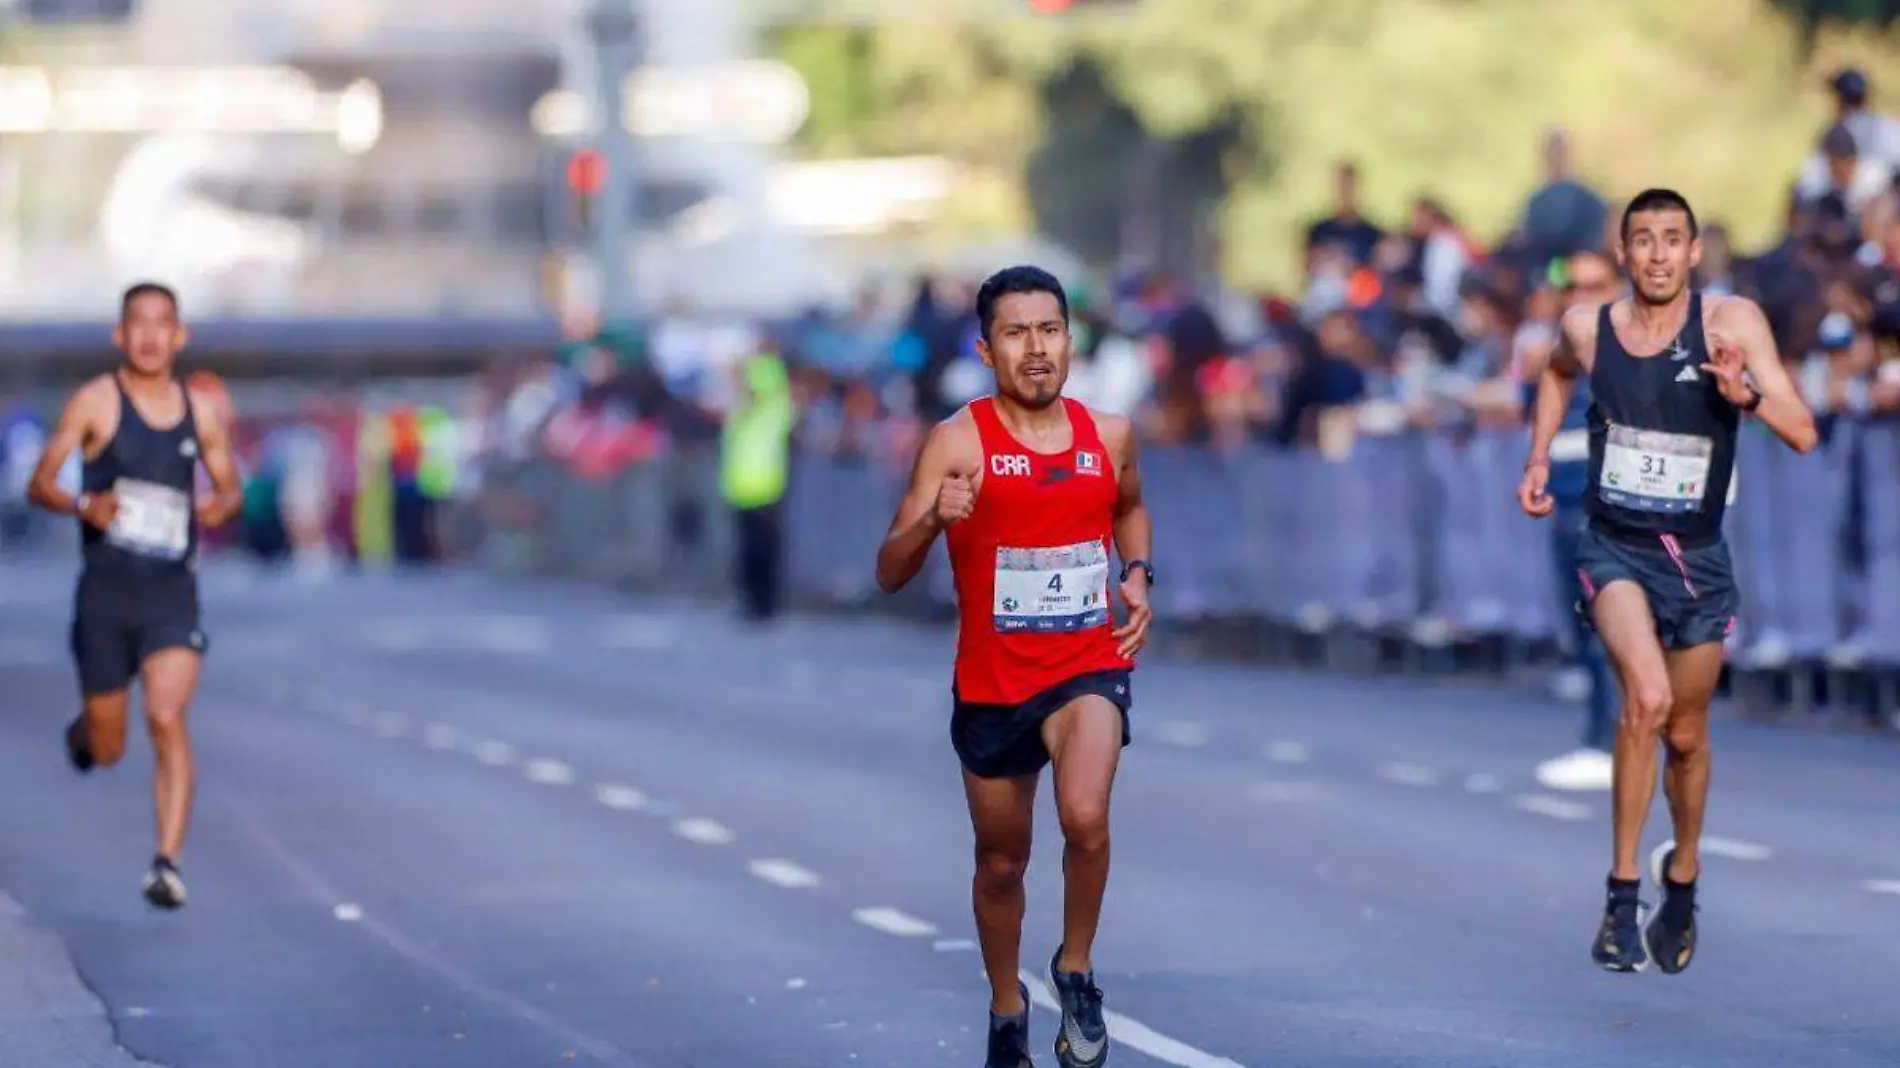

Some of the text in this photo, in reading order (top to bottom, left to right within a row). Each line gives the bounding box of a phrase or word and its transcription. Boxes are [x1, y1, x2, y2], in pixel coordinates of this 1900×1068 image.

[991, 454, 1031, 476] CRR
[1640, 455, 1666, 476] 31
[1047, 573, 1063, 593] 4
